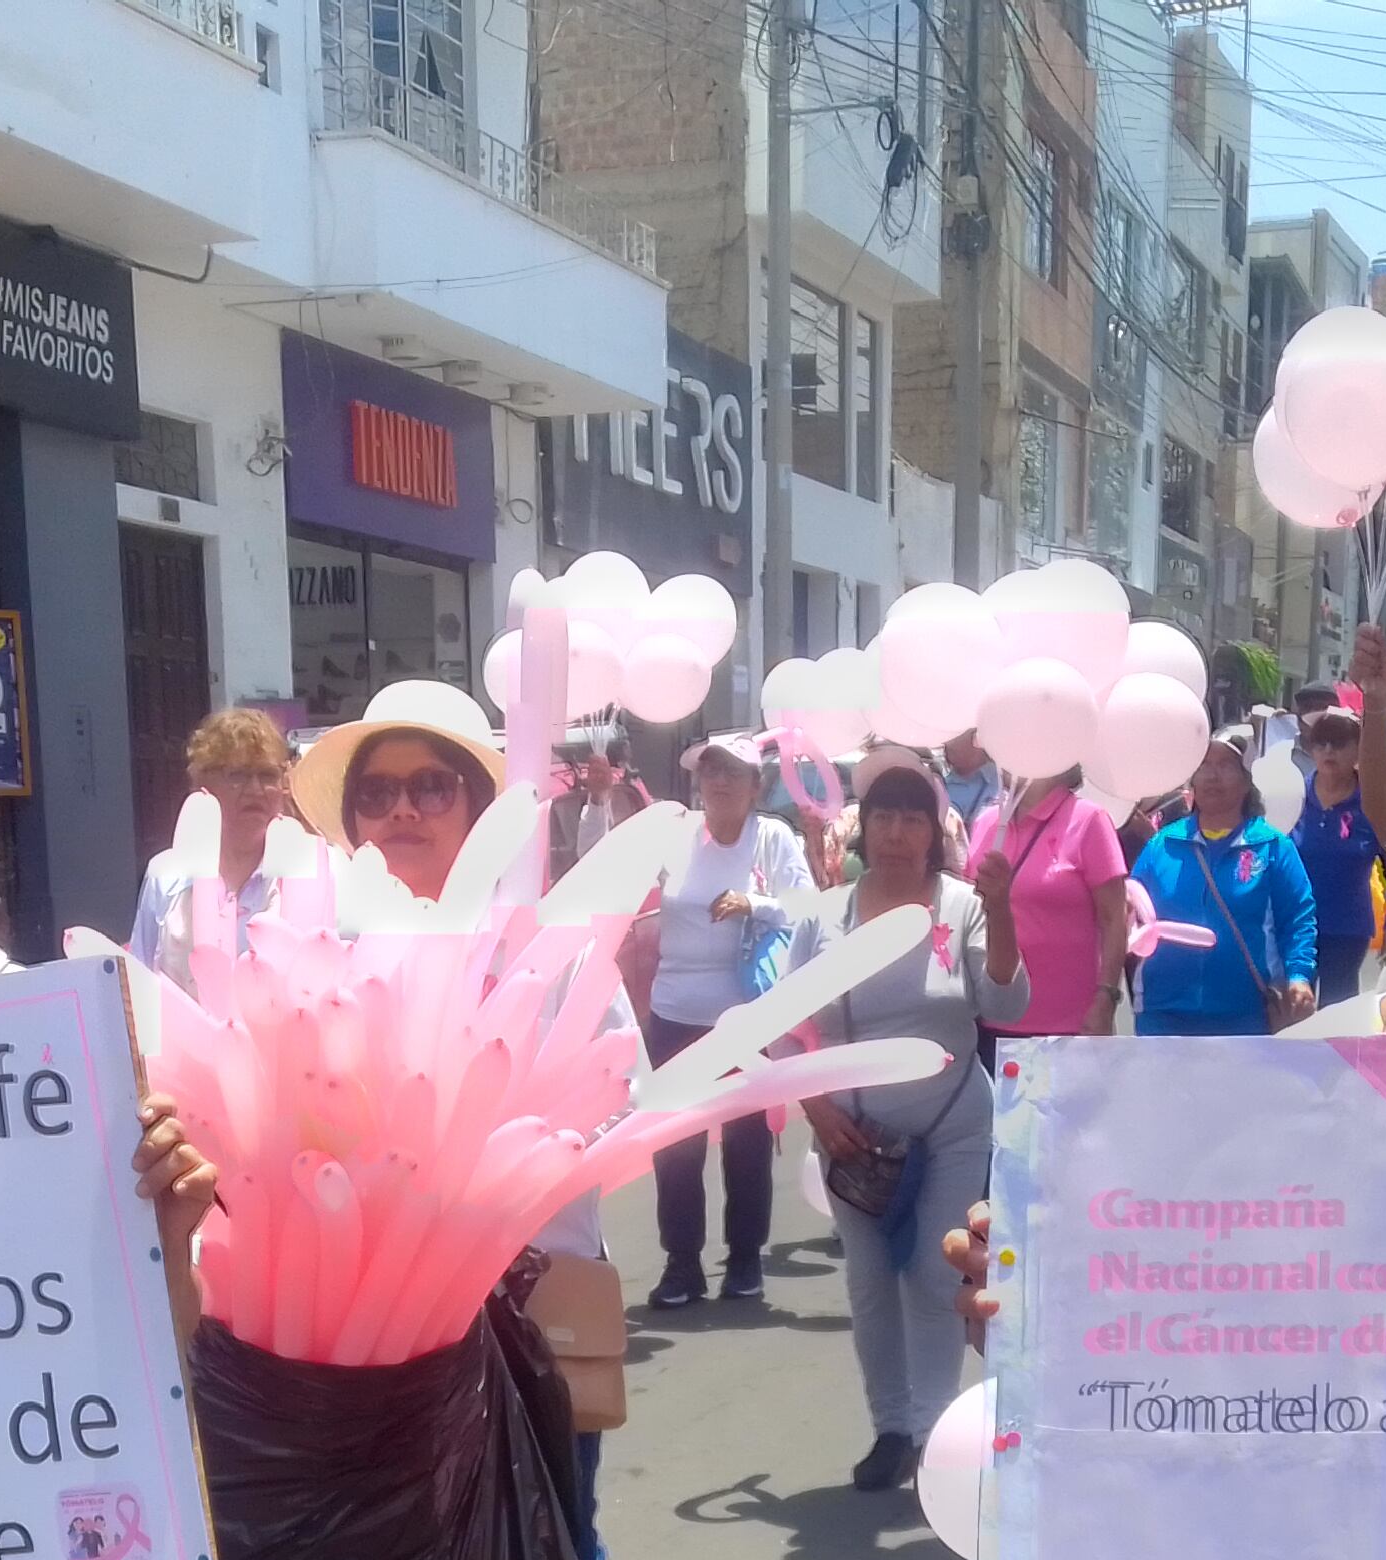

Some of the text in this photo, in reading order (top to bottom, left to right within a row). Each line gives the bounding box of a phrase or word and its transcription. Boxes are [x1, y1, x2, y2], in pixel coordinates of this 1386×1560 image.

[2, 319, 113, 383] FAVORITOS
[351, 400, 458, 508] TENDENZA
[1088, 1184, 1346, 1241] Campaña
[1088, 1249, 1331, 1292] Nacional
[1082, 1311, 1143, 1357] el
[1144, 1308, 1340, 1357] Cáncer
